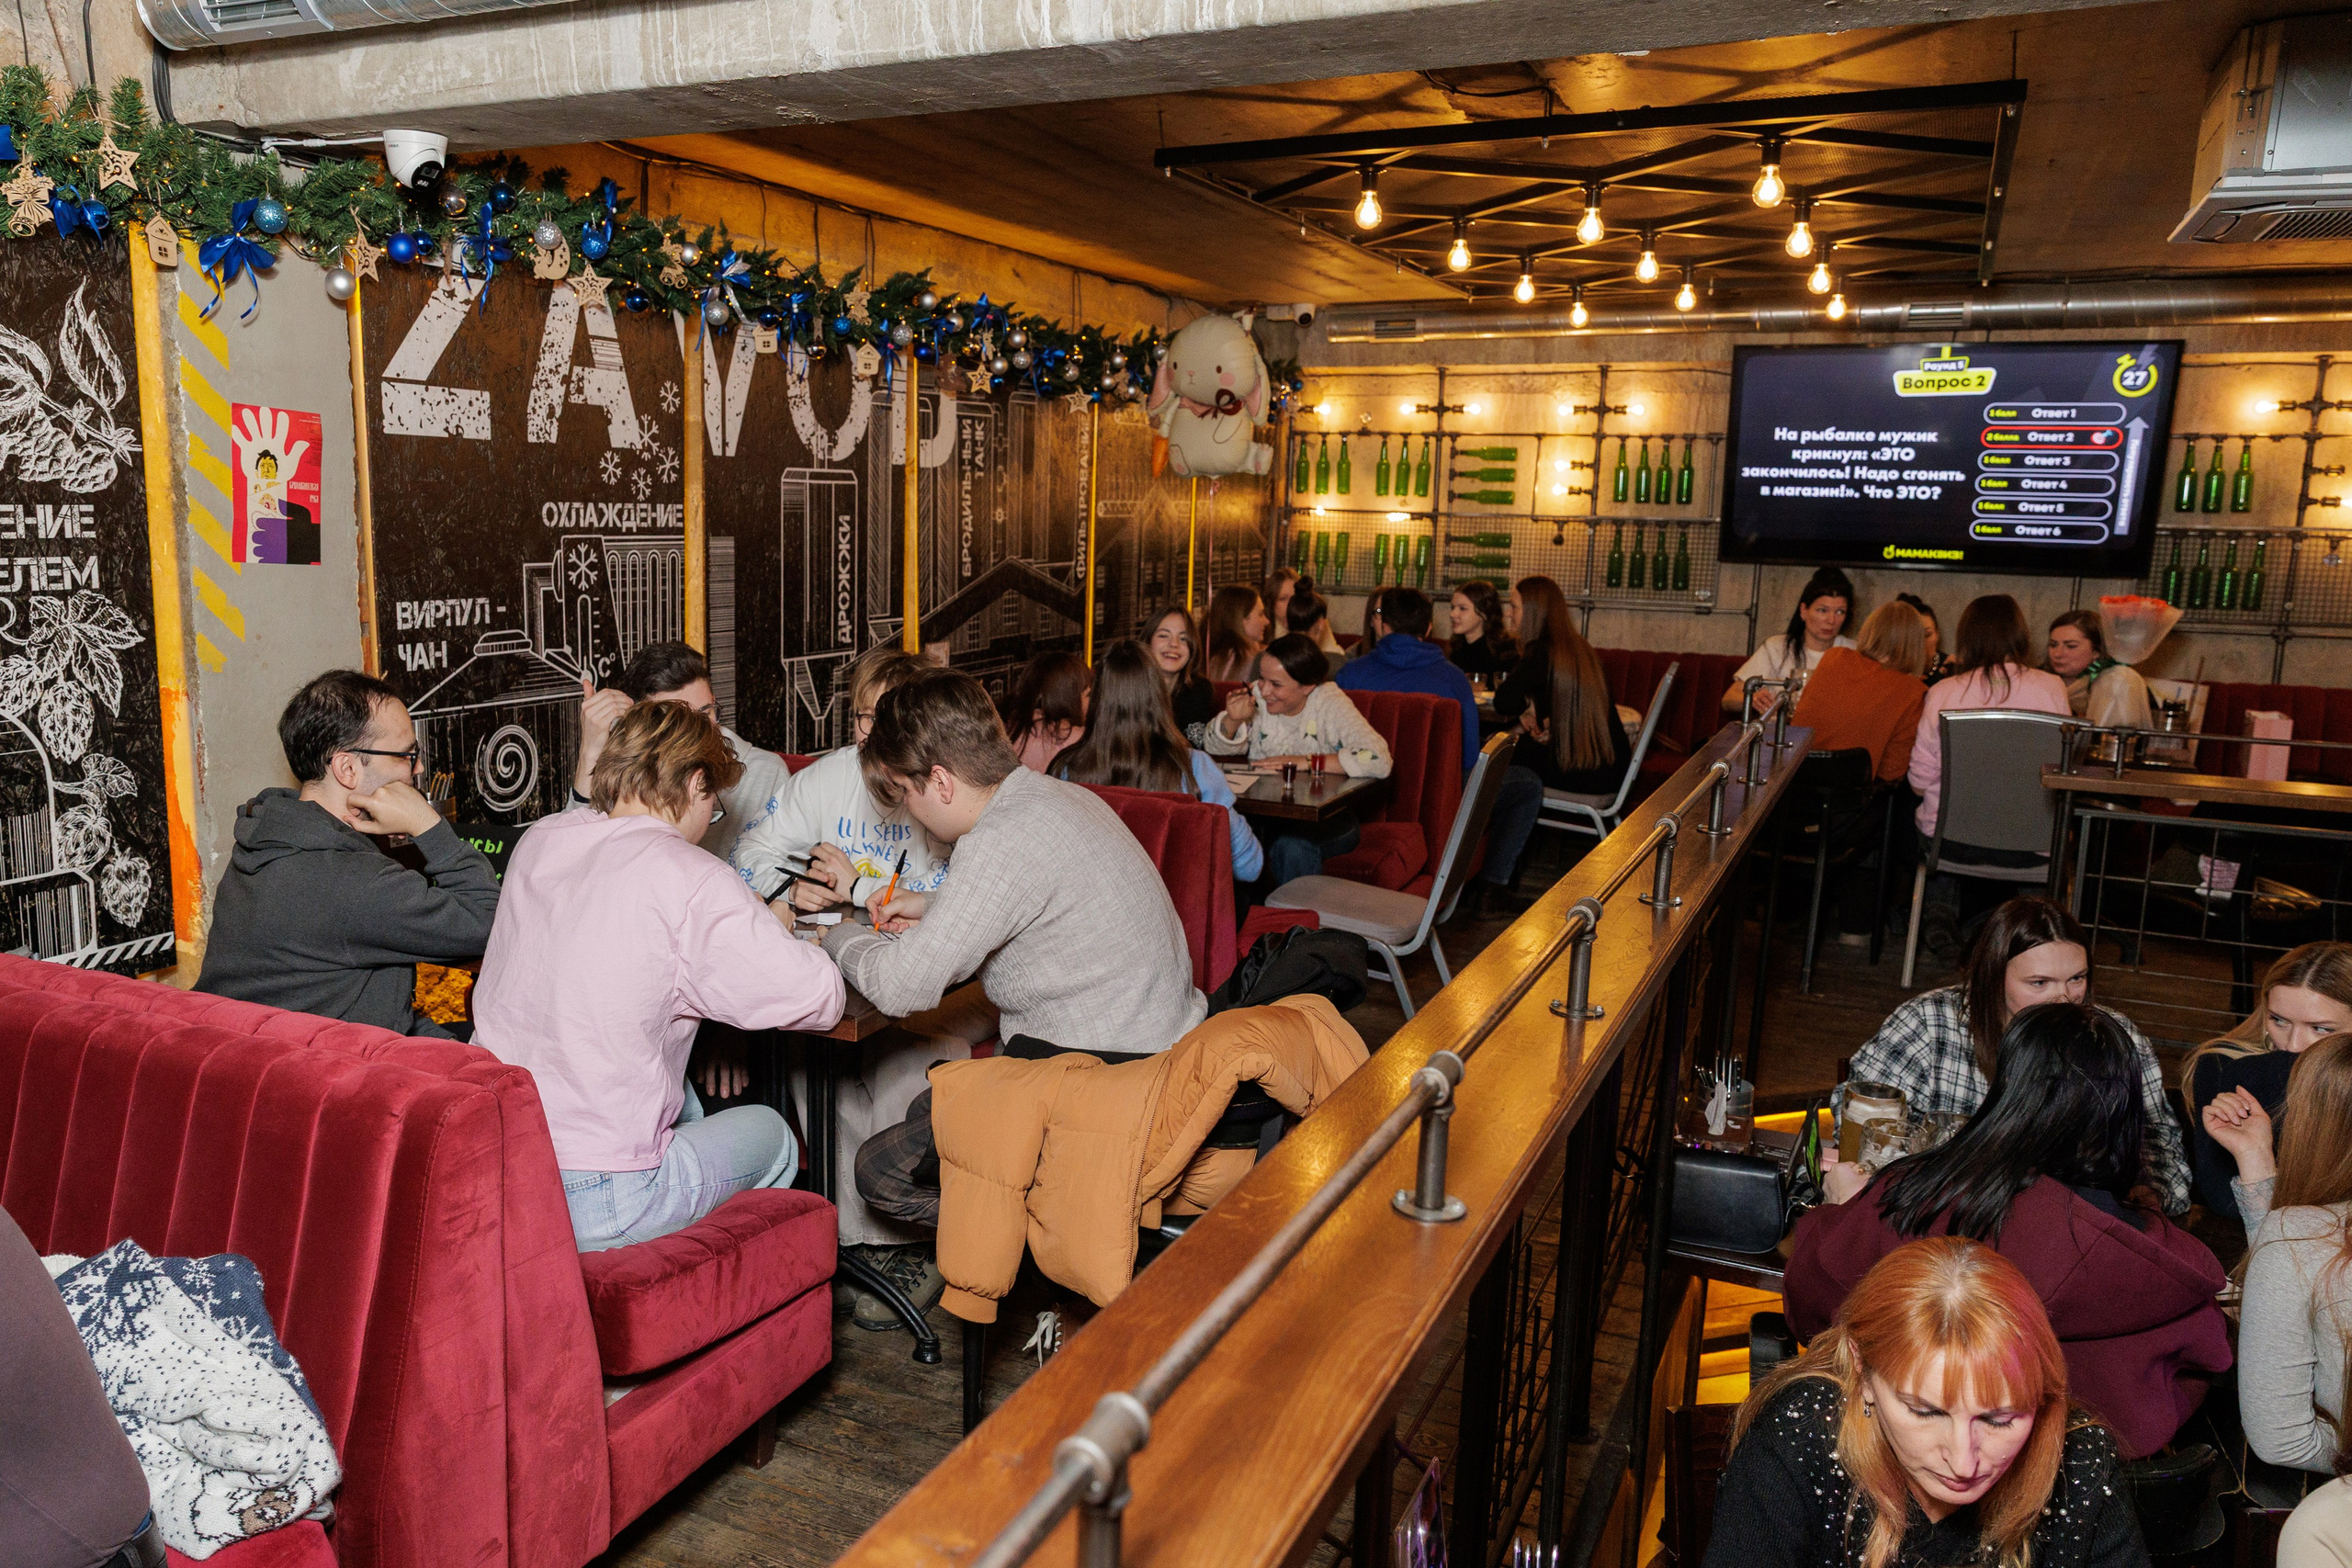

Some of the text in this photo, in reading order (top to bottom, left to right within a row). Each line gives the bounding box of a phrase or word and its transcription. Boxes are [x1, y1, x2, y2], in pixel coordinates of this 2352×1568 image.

[1903, 375, 1985, 391] Вопрос 2
[2121, 370, 2149, 386] 27
[2031, 408, 2076, 418] Ответ 1
[1774, 426, 1939, 445] На рыбалке мужик
[2027, 432, 2075, 442] Ответ 2
[975, 420, 985, 479] ТАНК
[1792, 447, 1916, 463] крикнул: «ЭТО
[2024, 456, 2071, 466] Ответ 3
[1741, 465, 1966, 481] закончилось! Надо сгонять
[2021, 479, 2067, 490] Ответ 4
[1760, 486, 1770, 496] в
[1863, 485, 1894, 499] Что
[1896, 485, 1942, 501] ЭТО?
[2018, 502, 2064, 513] Ответ 5
[541, 501, 684, 533] ОХЛАЖДЕНИЕ
[2015, 525, 2062, 536] Ответ 6
[838, 515, 853, 643] ДРОЖЖИ
[398, 641, 447, 671] ЧАН
